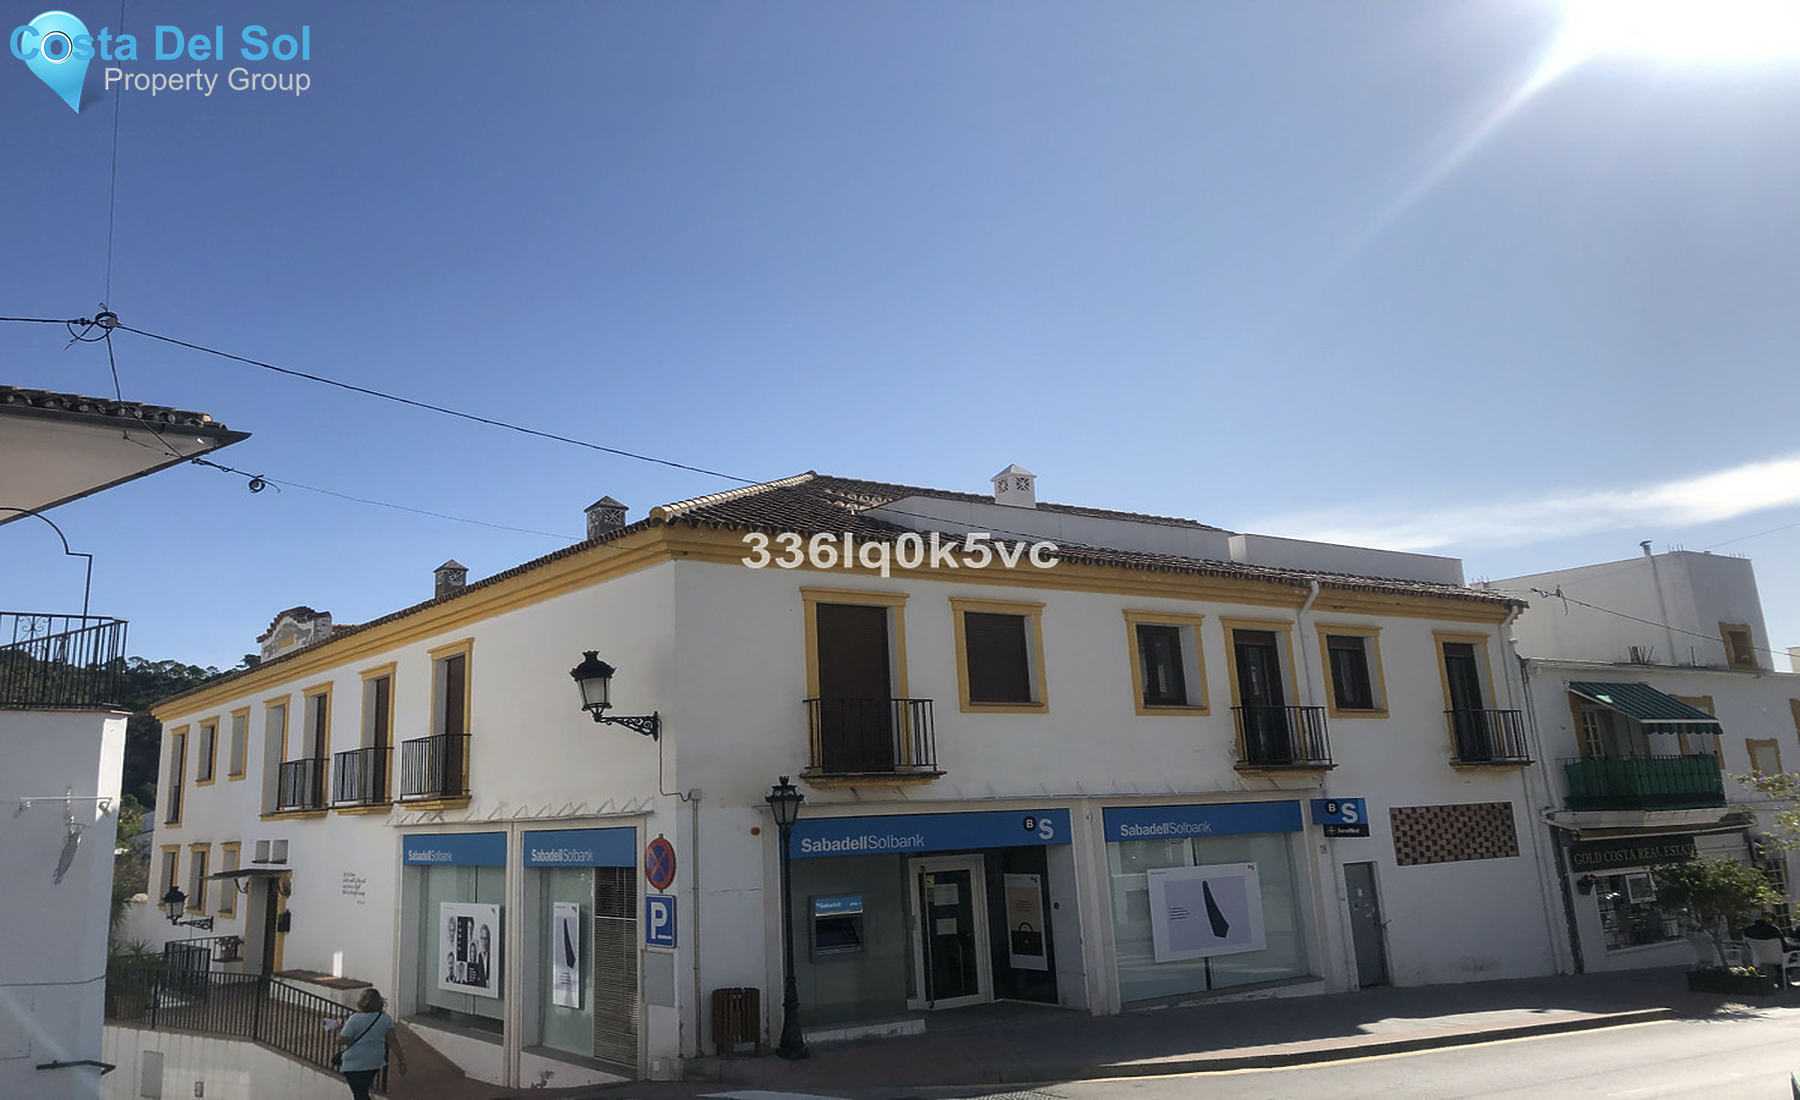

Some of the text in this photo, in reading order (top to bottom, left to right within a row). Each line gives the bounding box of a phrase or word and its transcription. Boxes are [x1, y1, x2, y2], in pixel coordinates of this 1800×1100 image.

[1328, 802, 1358, 823] B S
[1025, 818, 1054, 839] B S
[801, 834, 925, 853] SabadellSolbank
[530, 848, 595, 863] SabadellSolbank
[1574, 851, 1601, 865] GOLD
[1602, 848, 1636, 863] COSTA
[651, 901, 668, 939] P
